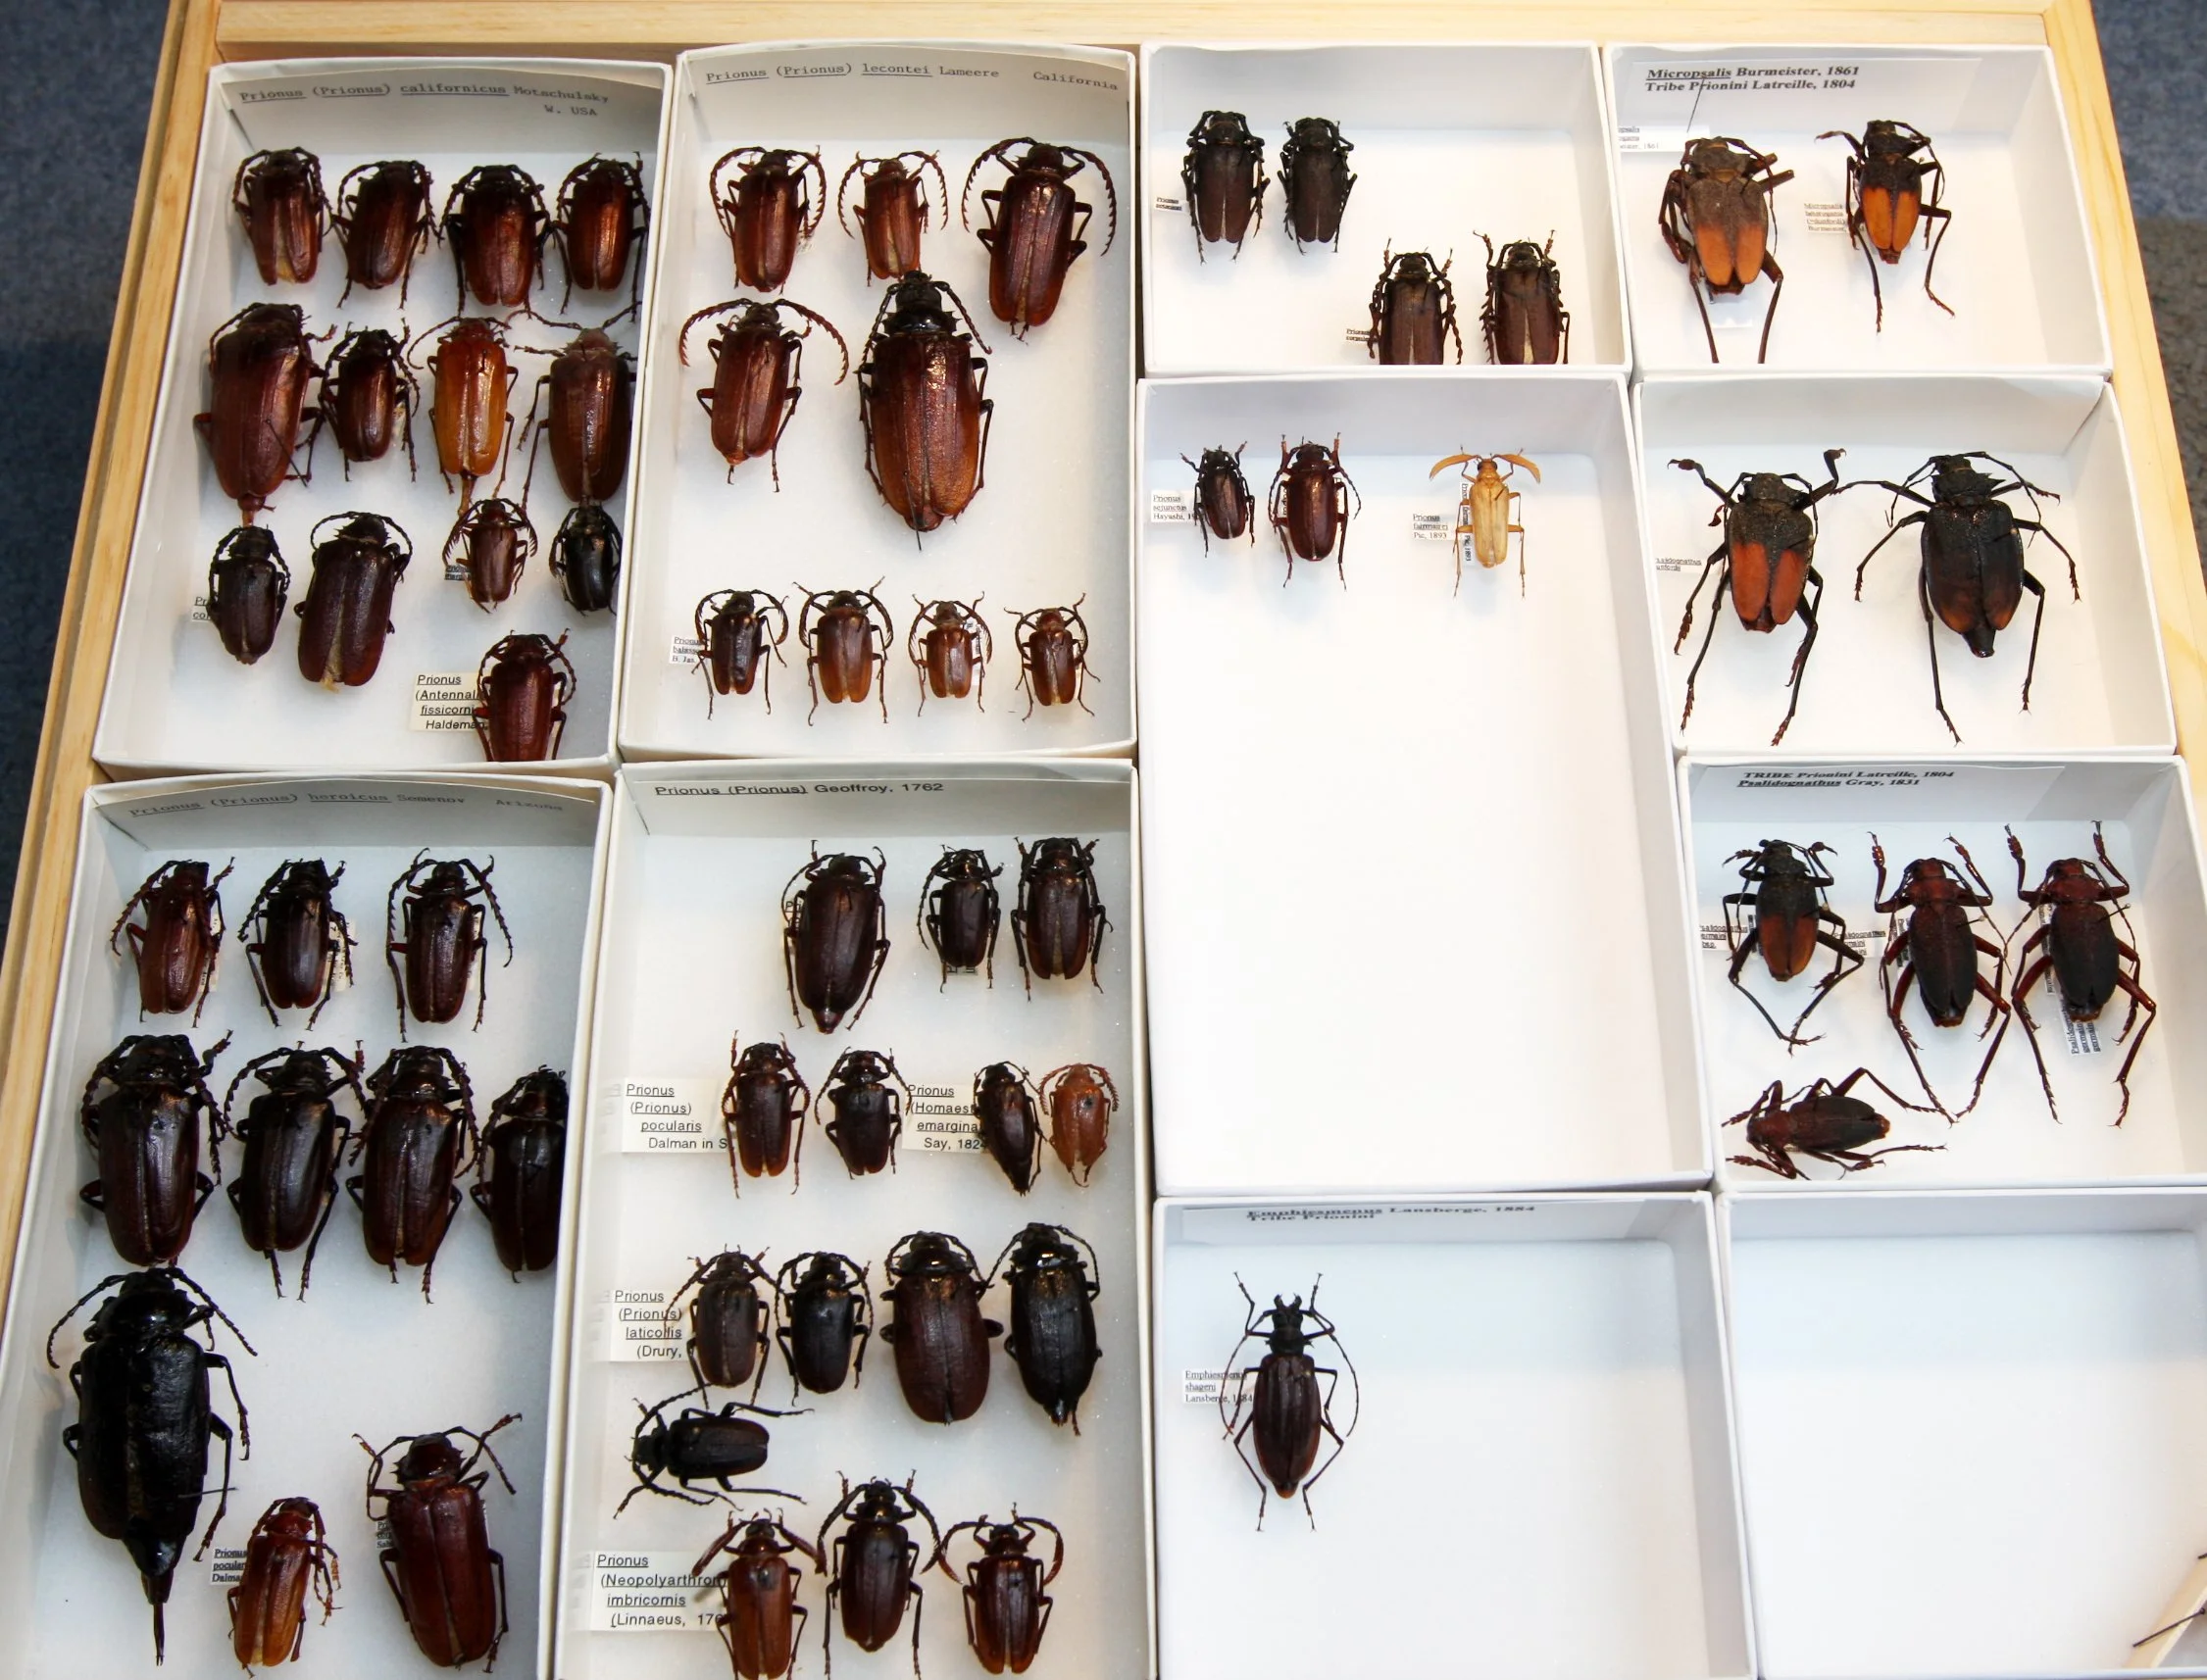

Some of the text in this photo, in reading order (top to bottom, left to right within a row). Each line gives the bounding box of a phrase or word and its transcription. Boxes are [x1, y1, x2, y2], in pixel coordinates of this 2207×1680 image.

[706, 63, 1119, 90] Prionus (Prionus) lecontei Lameere California
[1646, 66, 1859, 80] Micropsalis Burmeister, 1861
[1645, 79, 1855, 91] Tribe Prionini Latreille, 1804
[238, 83, 609, 104] Prionus (Prionus) californicus Motschulsky
[544, 104, 597, 117] W. USA
[674, 637, 703, 646] Prionu
[417, 674, 462, 685] Prionus
[415, 690, 479, 701] (Antennal
[420, 705, 475, 716] fissicorni
[655, 783, 944, 796] Prionus (Prionus) Geoffroy, 1762
[128, 802, 205, 817] Prionus
[211, 794, 298, 808] (Prionus)
[626, 1083, 675, 1097] Prionus
[908, 1084, 955, 1098] Prionus
[630, 1102, 691, 1115] (Prionus)
[911, 1102, 974, 1115] (Homaest
[640, 1120, 702, 1132] pocularis
[916, 1121, 978, 1133] emargina
[648, 1137, 727, 1149] Dalman in S
[924, 1137, 951, 1151] Say,
[615, 1290, 665, 1303] Prionus
[619, 1308, 682, 1321] (Prionus)
[626, 1326, 682, 1340] laticollis
[636, 1345, 681, 1359] (Drury,
[212, 1560, 246, 1571] pocular
[596, 1554, 649, 1568] Prionus
[212, 1573, 242, 1582] Dalma
[607, 1594, 686, 1607] imbricornis
[610, 1613, 685, 1628] (Linnaeus,
